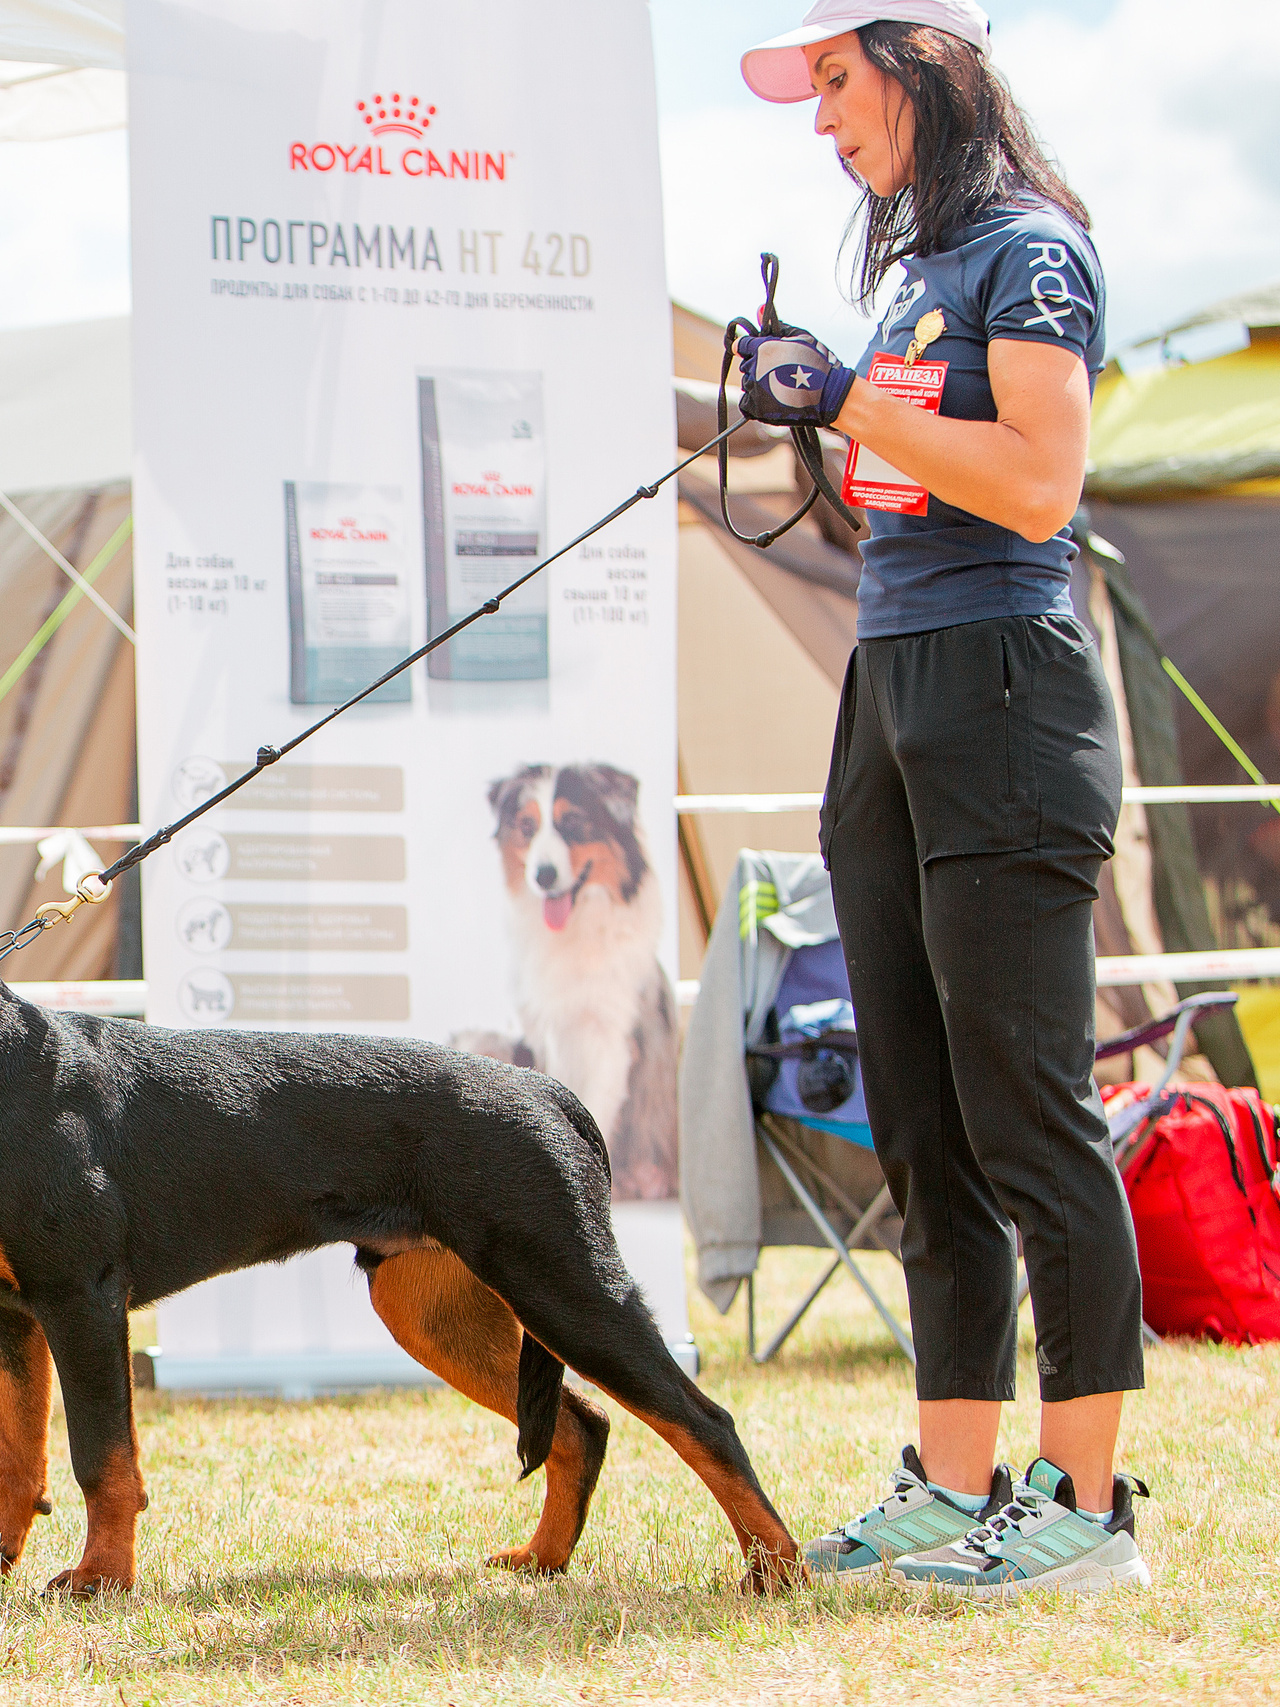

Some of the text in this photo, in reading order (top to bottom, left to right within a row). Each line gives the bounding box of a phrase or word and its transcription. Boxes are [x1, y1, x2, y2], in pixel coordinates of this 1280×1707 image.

[290, 142, 505, 181] ROYAL CANIN
[210, 214, 593, 278] ПРОГРАММА HT 42D
[210, 278, 594, 312] ПРОДУКТЫ ДЛЯ СОБАК С 1-ГО ДО 42-ГО ДНЯ БЕРЕМЕННОСТИ
[875, 366, 940, 385] ТРАПЕЗА
[852, 491, 919, 504] ПРОФЕССИОНАЛЬНЫЕ
[864, 499, 902, 508] ЗАВОДЧИКИ
[196, 553, 234, 569] собак
